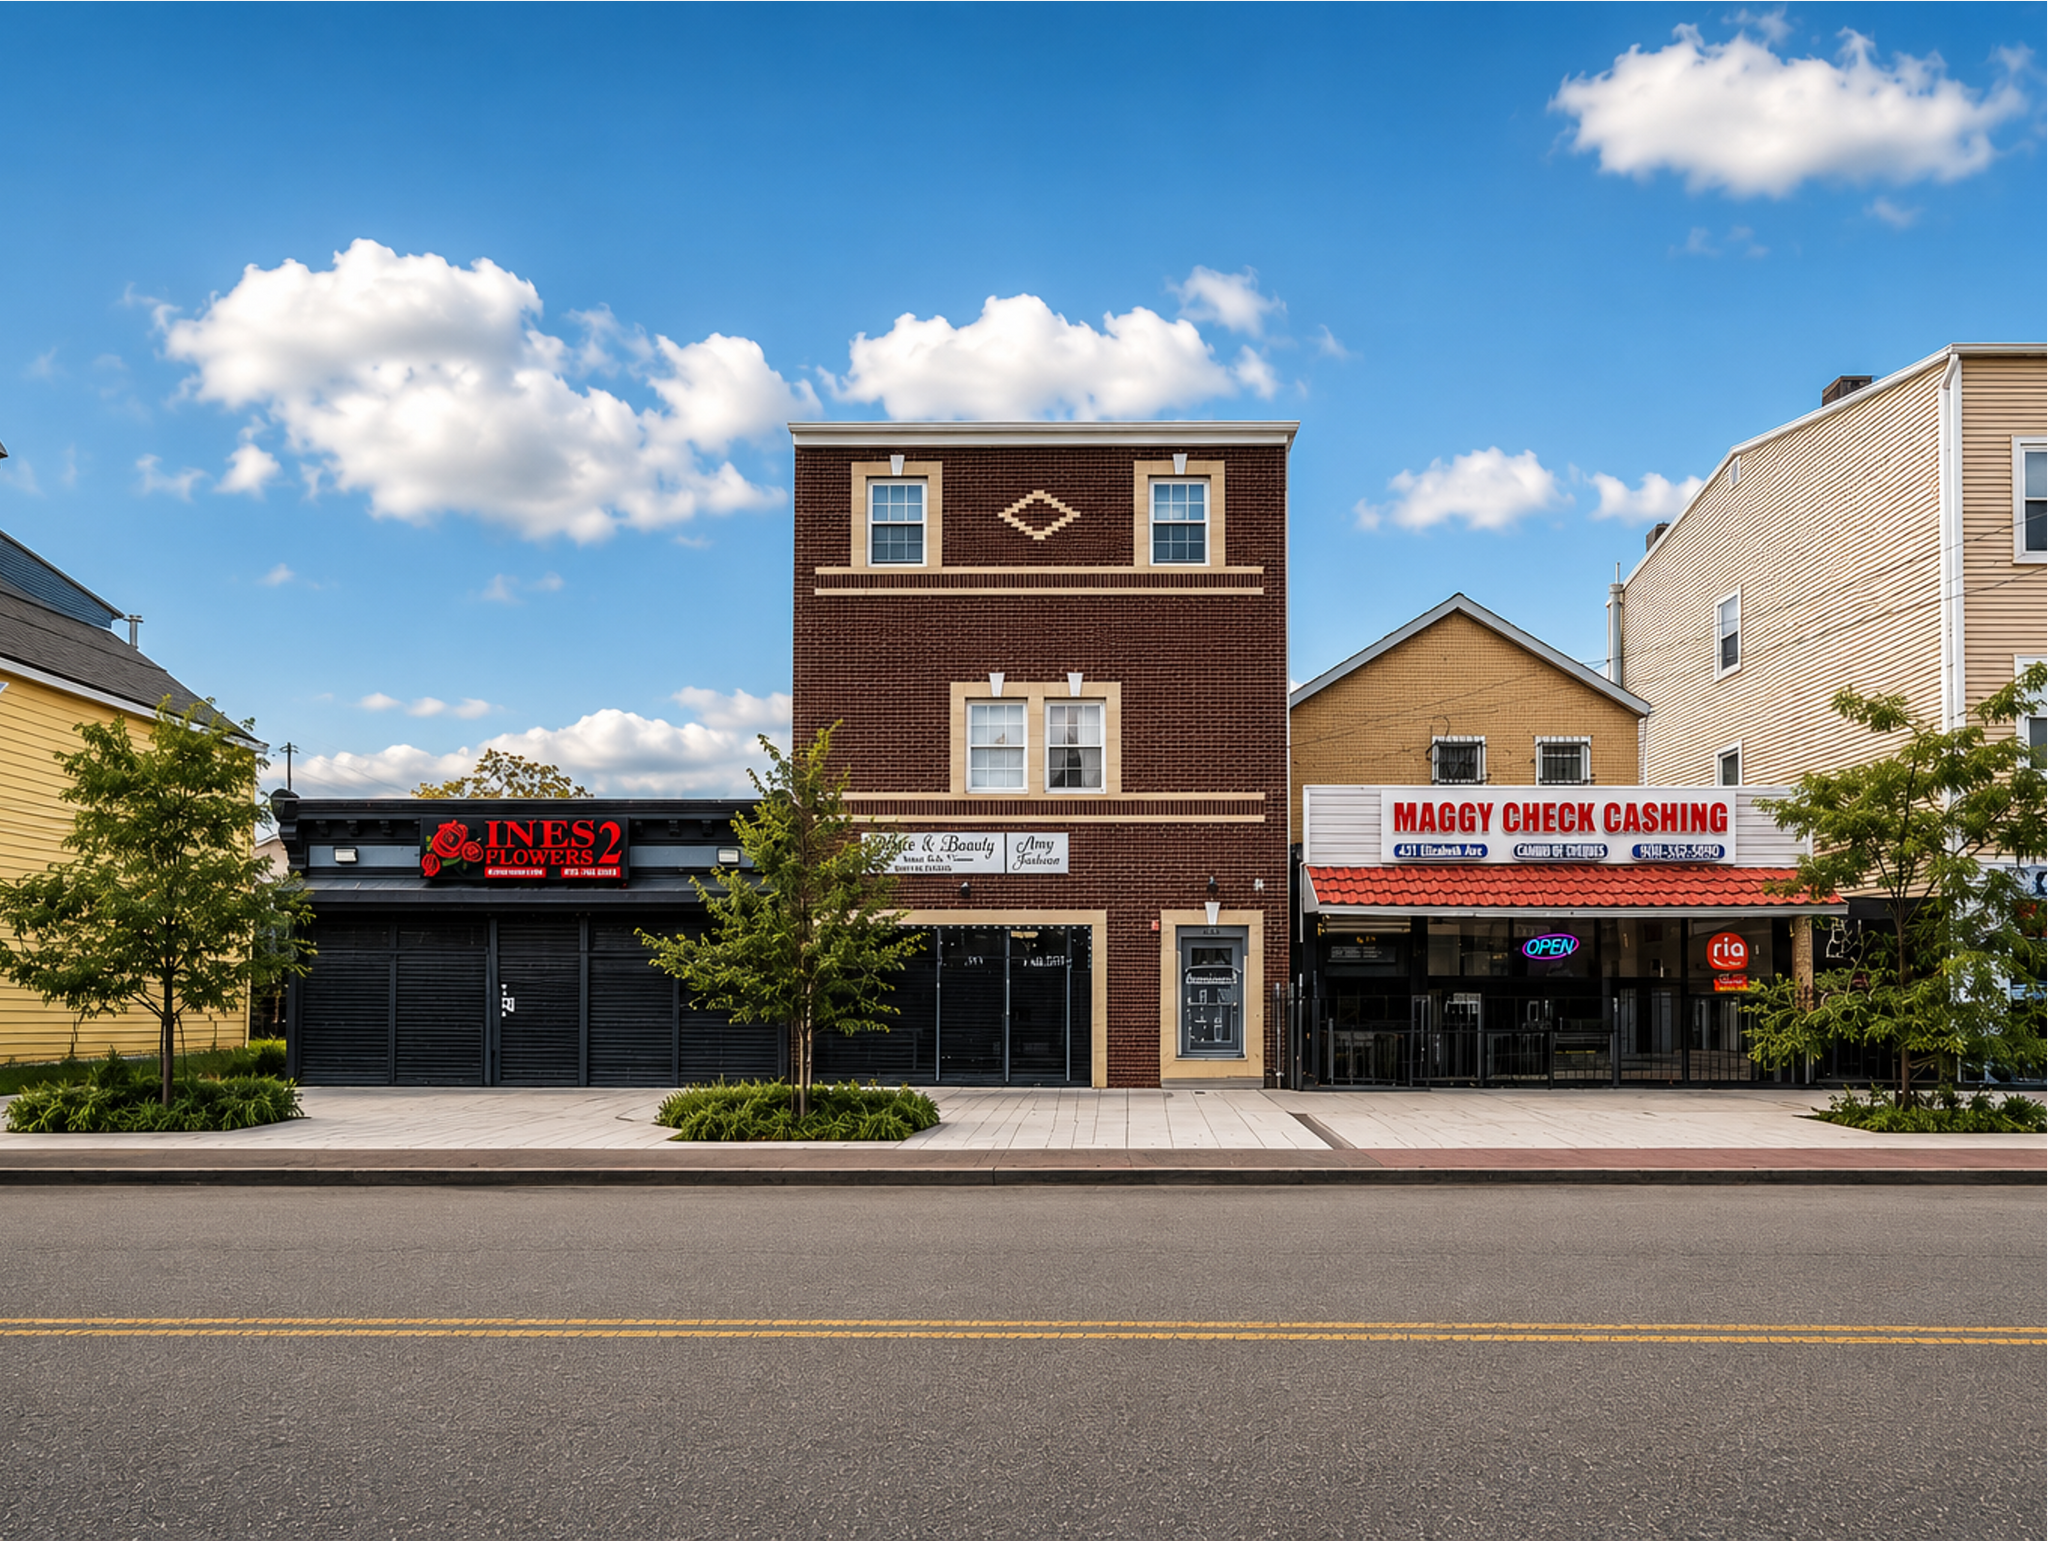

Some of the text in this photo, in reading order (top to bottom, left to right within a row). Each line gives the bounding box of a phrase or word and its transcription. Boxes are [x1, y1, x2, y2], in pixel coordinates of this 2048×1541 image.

[1393, 801, 1729, 834] MAGGY CHECK CASHING
[485, 819, 622, 864] INES 2
[485, 849, 594, 865] FLOWERS
[1526, 938, 1575, 955] OPEN
[1713, 936, 1745, 957] ria
